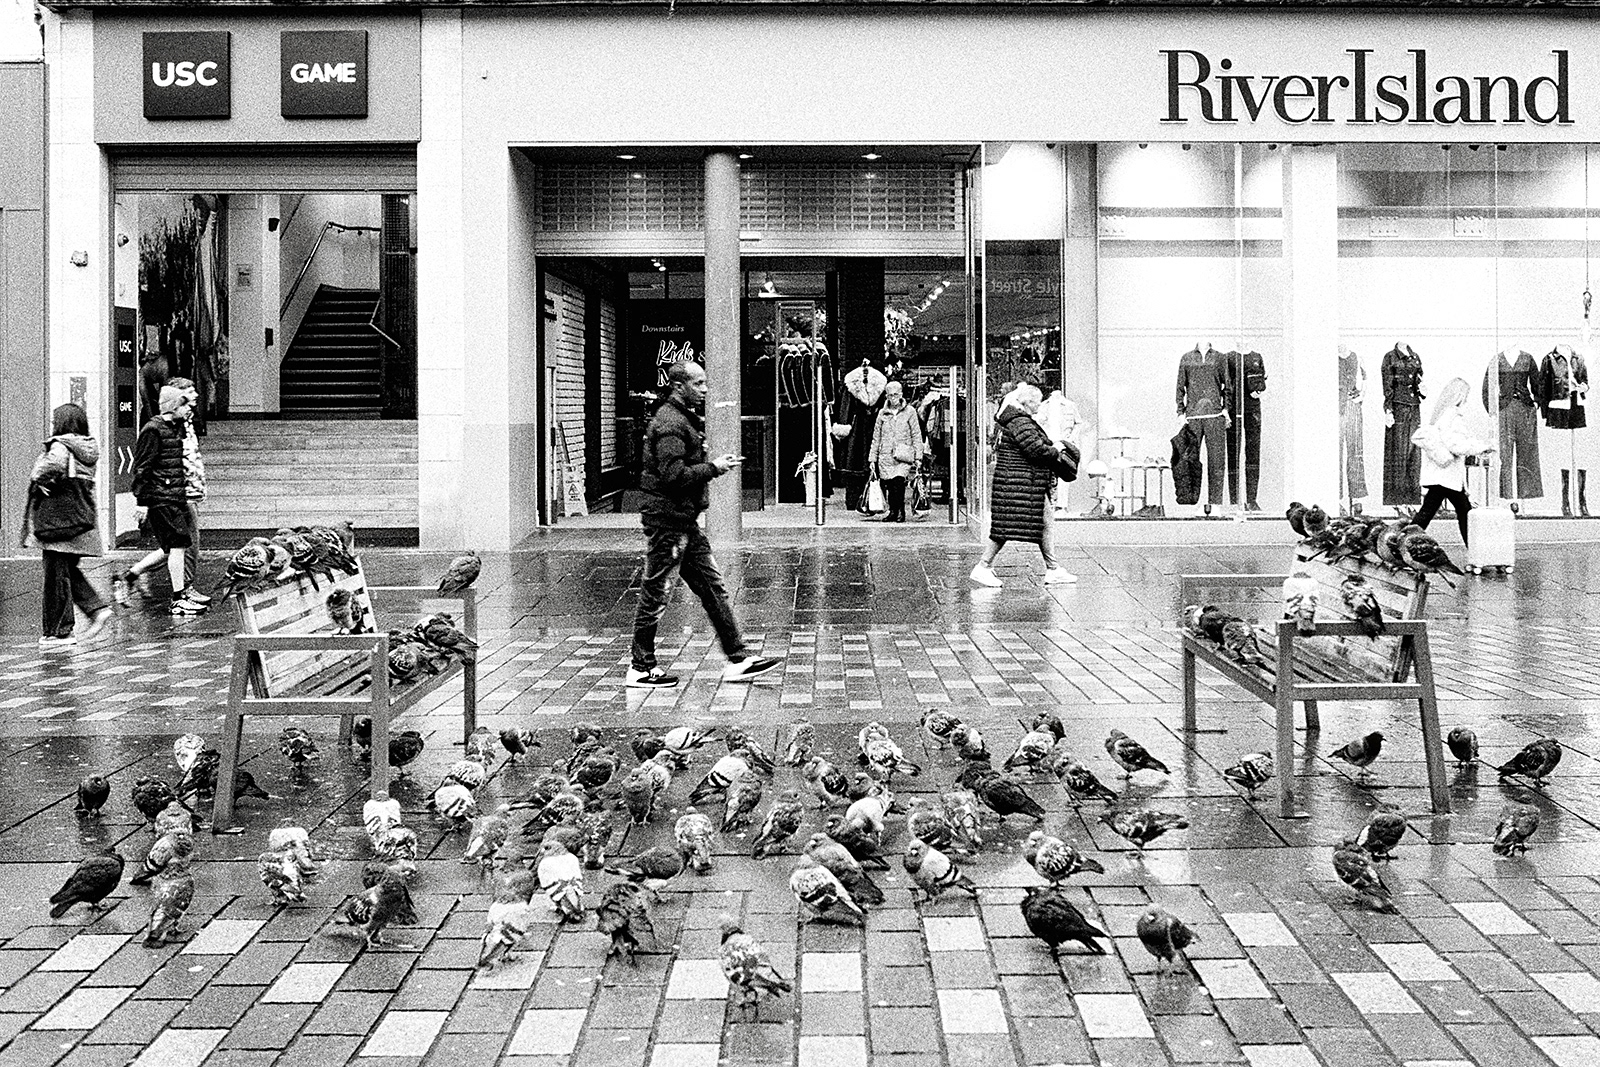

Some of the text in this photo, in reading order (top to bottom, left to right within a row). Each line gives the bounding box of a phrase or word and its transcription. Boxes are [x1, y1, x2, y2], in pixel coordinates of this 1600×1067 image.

[152, 61, 218, 87] USC
[290, 63, 356, 83] GAME
[641, 324, 685, 333] Downstairs
[119, 340, 132, 353] USC
[656, 340, 694, 366] Kids
[119, 401, 132, 412] GAME
